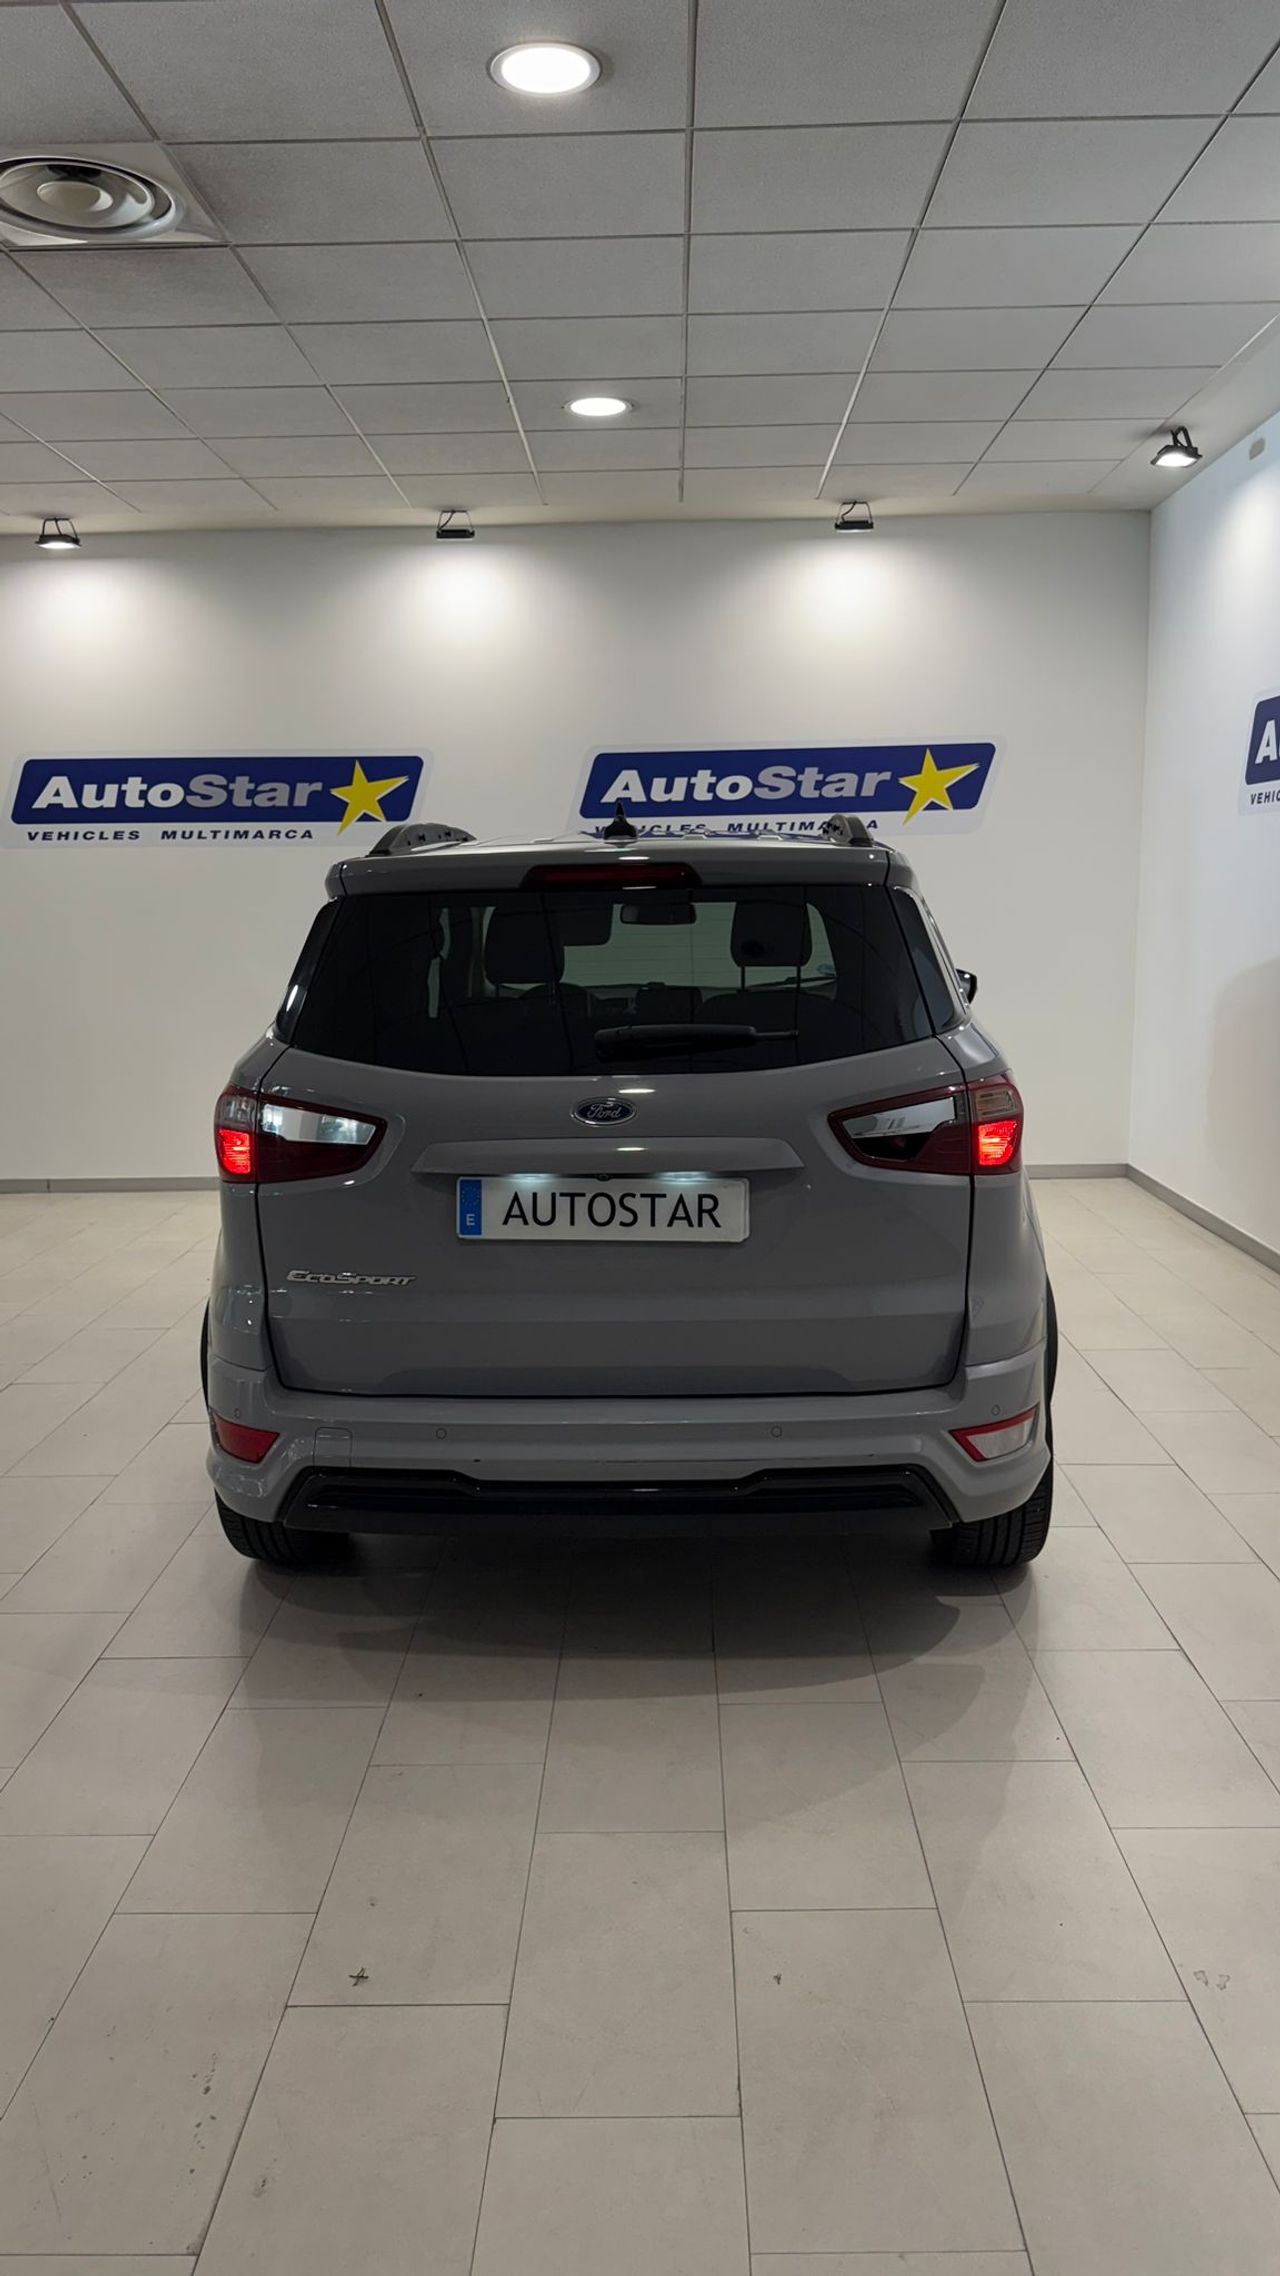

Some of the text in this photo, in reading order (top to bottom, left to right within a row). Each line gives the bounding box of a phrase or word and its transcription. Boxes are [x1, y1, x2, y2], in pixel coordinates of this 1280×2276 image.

[1255, 719, 1280, 765] A
[31, 774, 323, 809] AutoStar
[600, 765, 891, 803] AutoStar
[26, 829, 314, 841] VEHICLES MULTIMARCA
[587, 1101, 622, 1118] Ford
[466, 1191, 721, 1228] E AUTOSTAR
